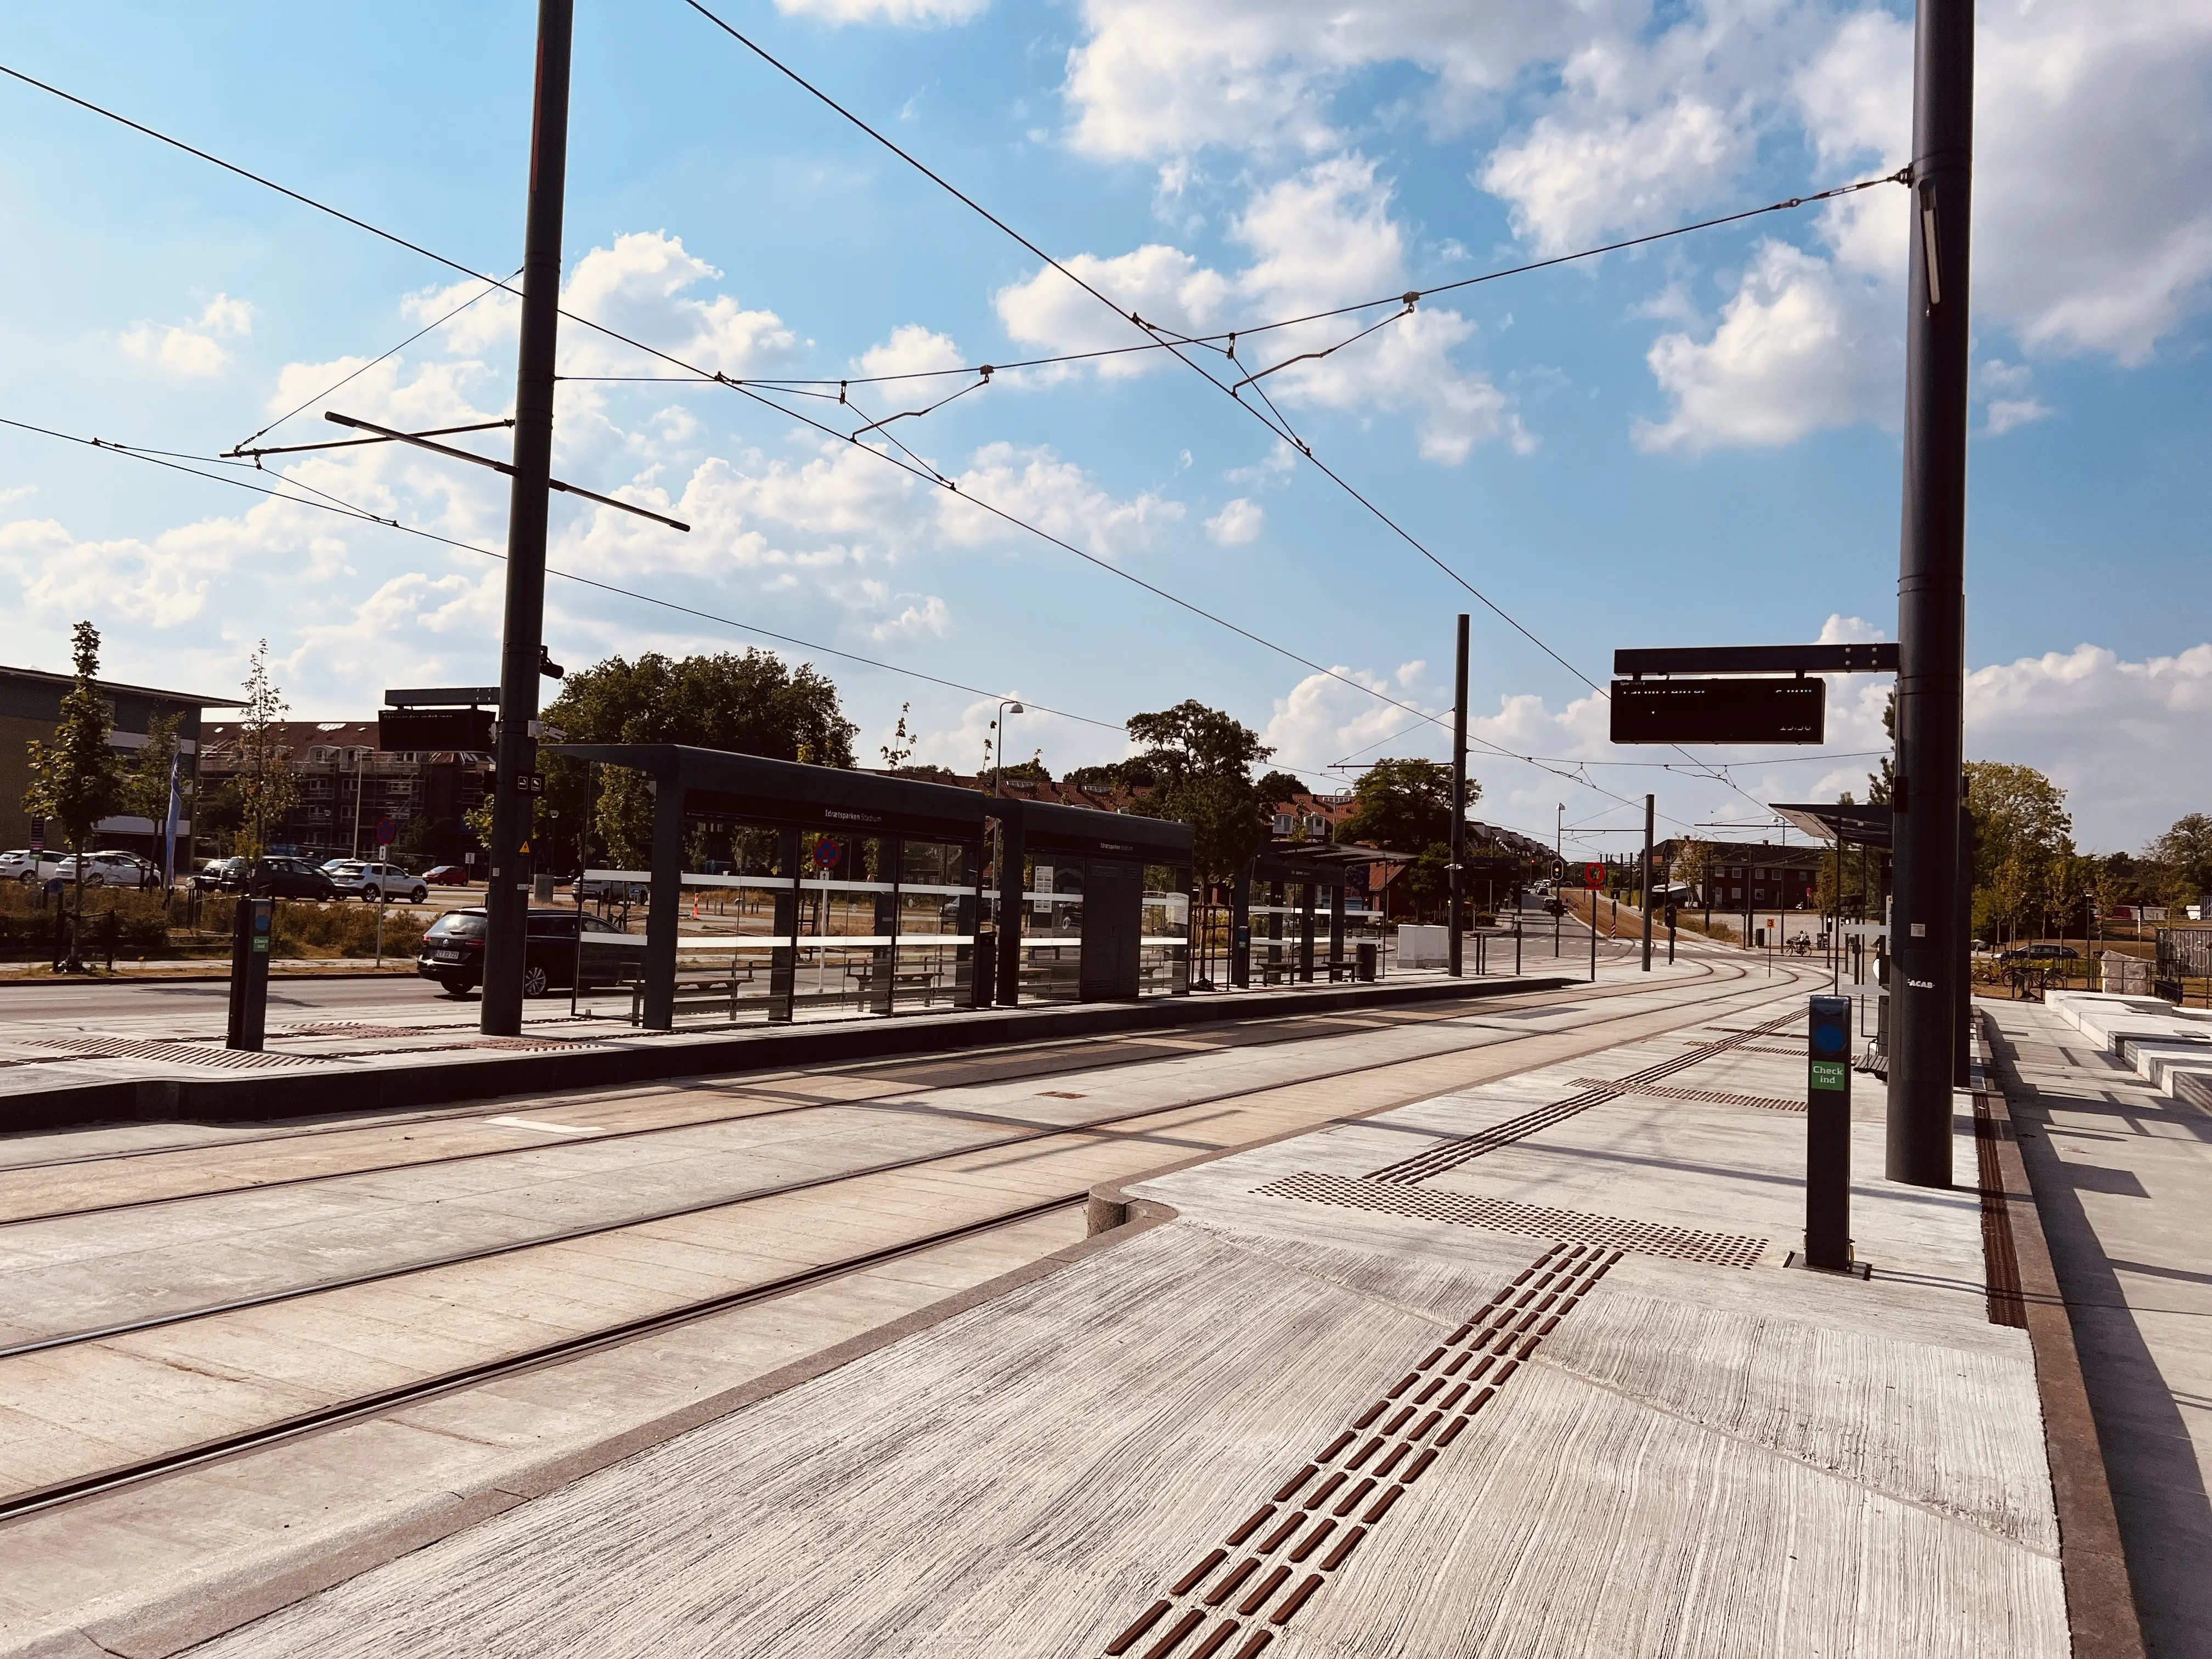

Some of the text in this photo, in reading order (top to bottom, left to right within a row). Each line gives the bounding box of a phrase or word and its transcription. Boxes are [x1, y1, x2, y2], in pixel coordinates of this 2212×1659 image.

[825, 809, 882, 822] Idrætsparken Stadium
[1813, 1065, 1843, 1075] Check
[1820, 1075, 1836, 1084] ind
